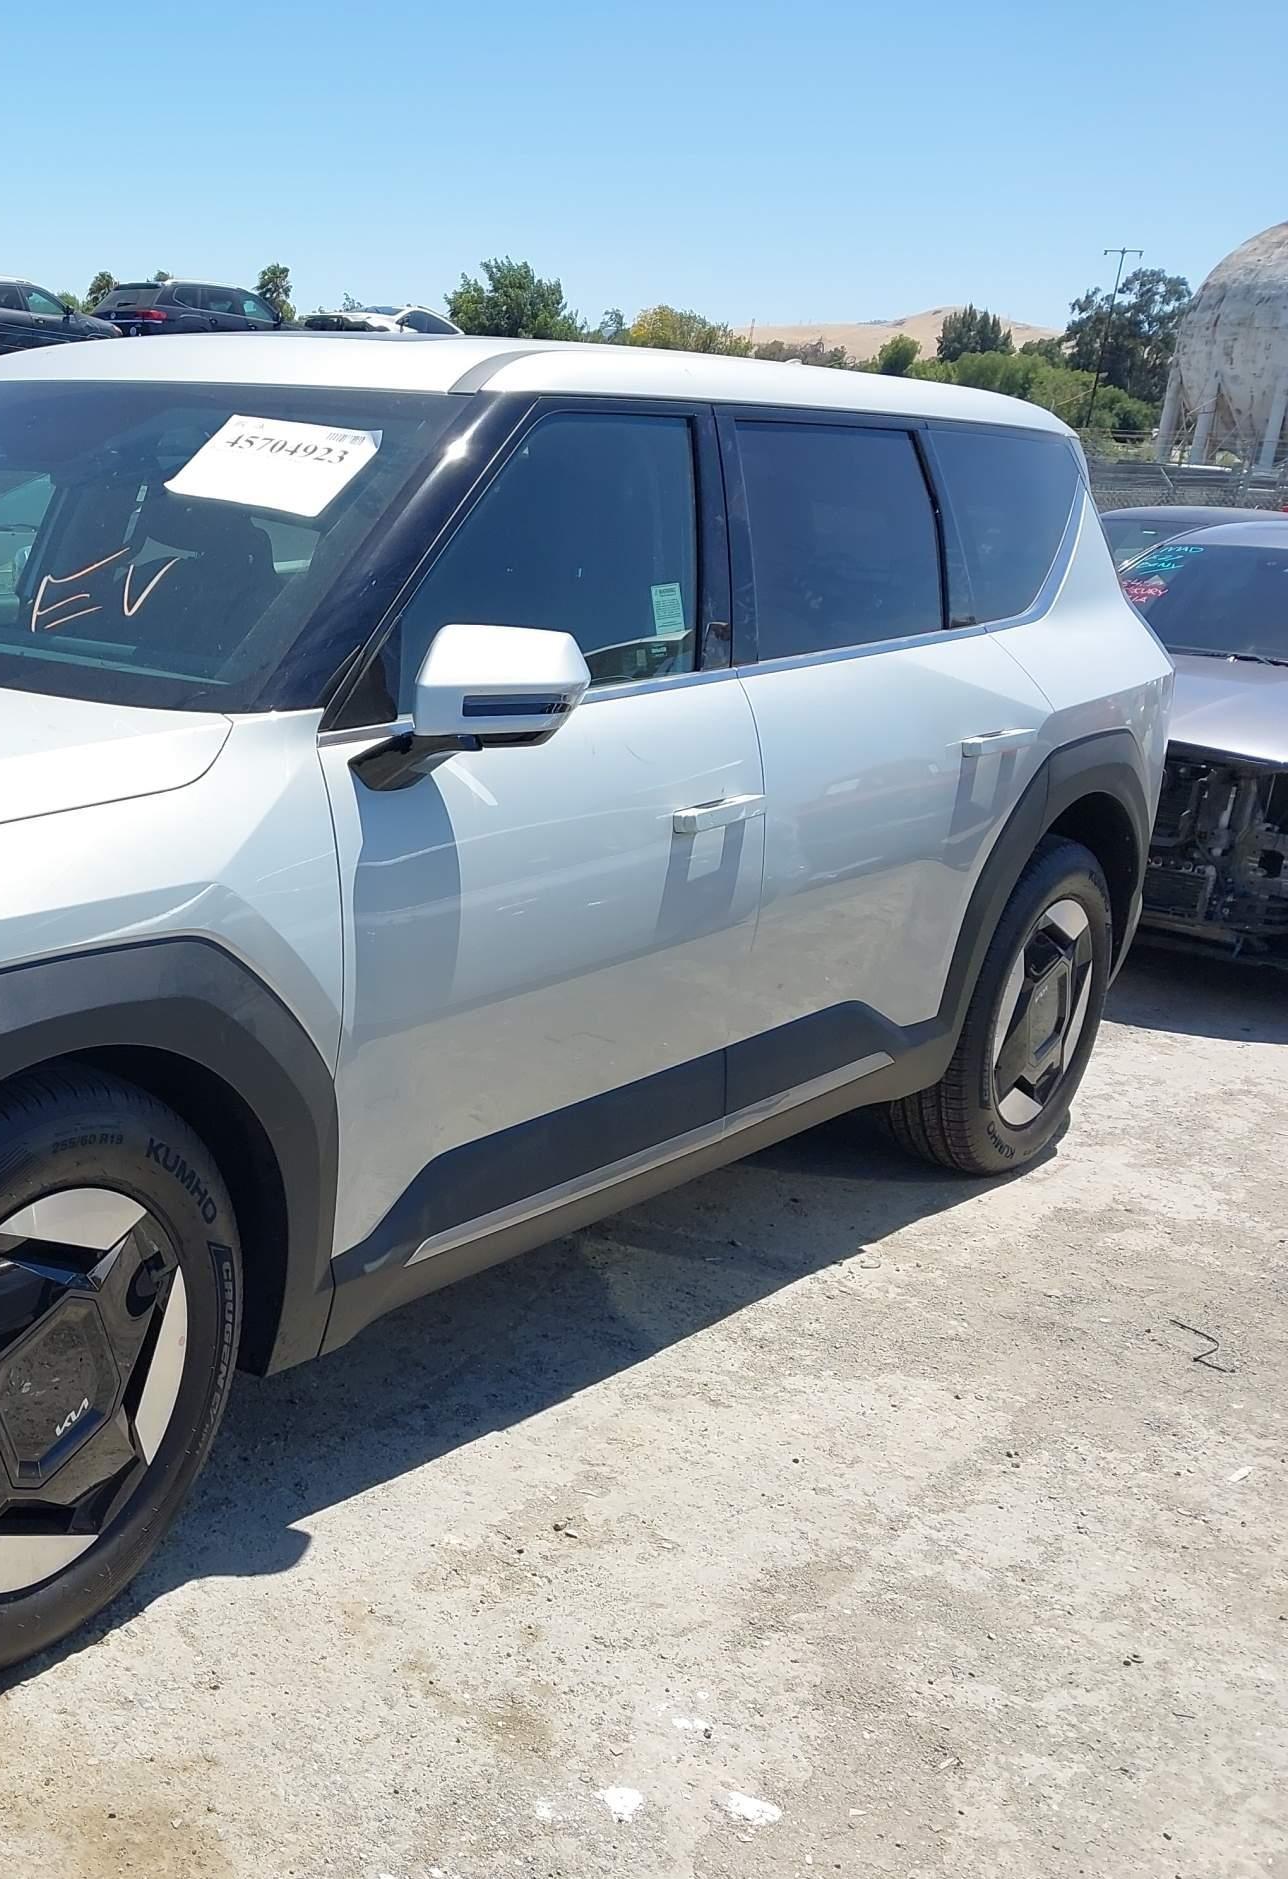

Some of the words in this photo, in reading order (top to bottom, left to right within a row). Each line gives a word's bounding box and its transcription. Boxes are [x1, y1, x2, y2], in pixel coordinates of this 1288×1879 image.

[225, 432, 350, 465] 45704923
[30, 546, 181, 633] EV
[144, 1136, 218, 1225] KUMHO
[216, 1260, 234, 1390] CRUGEN
